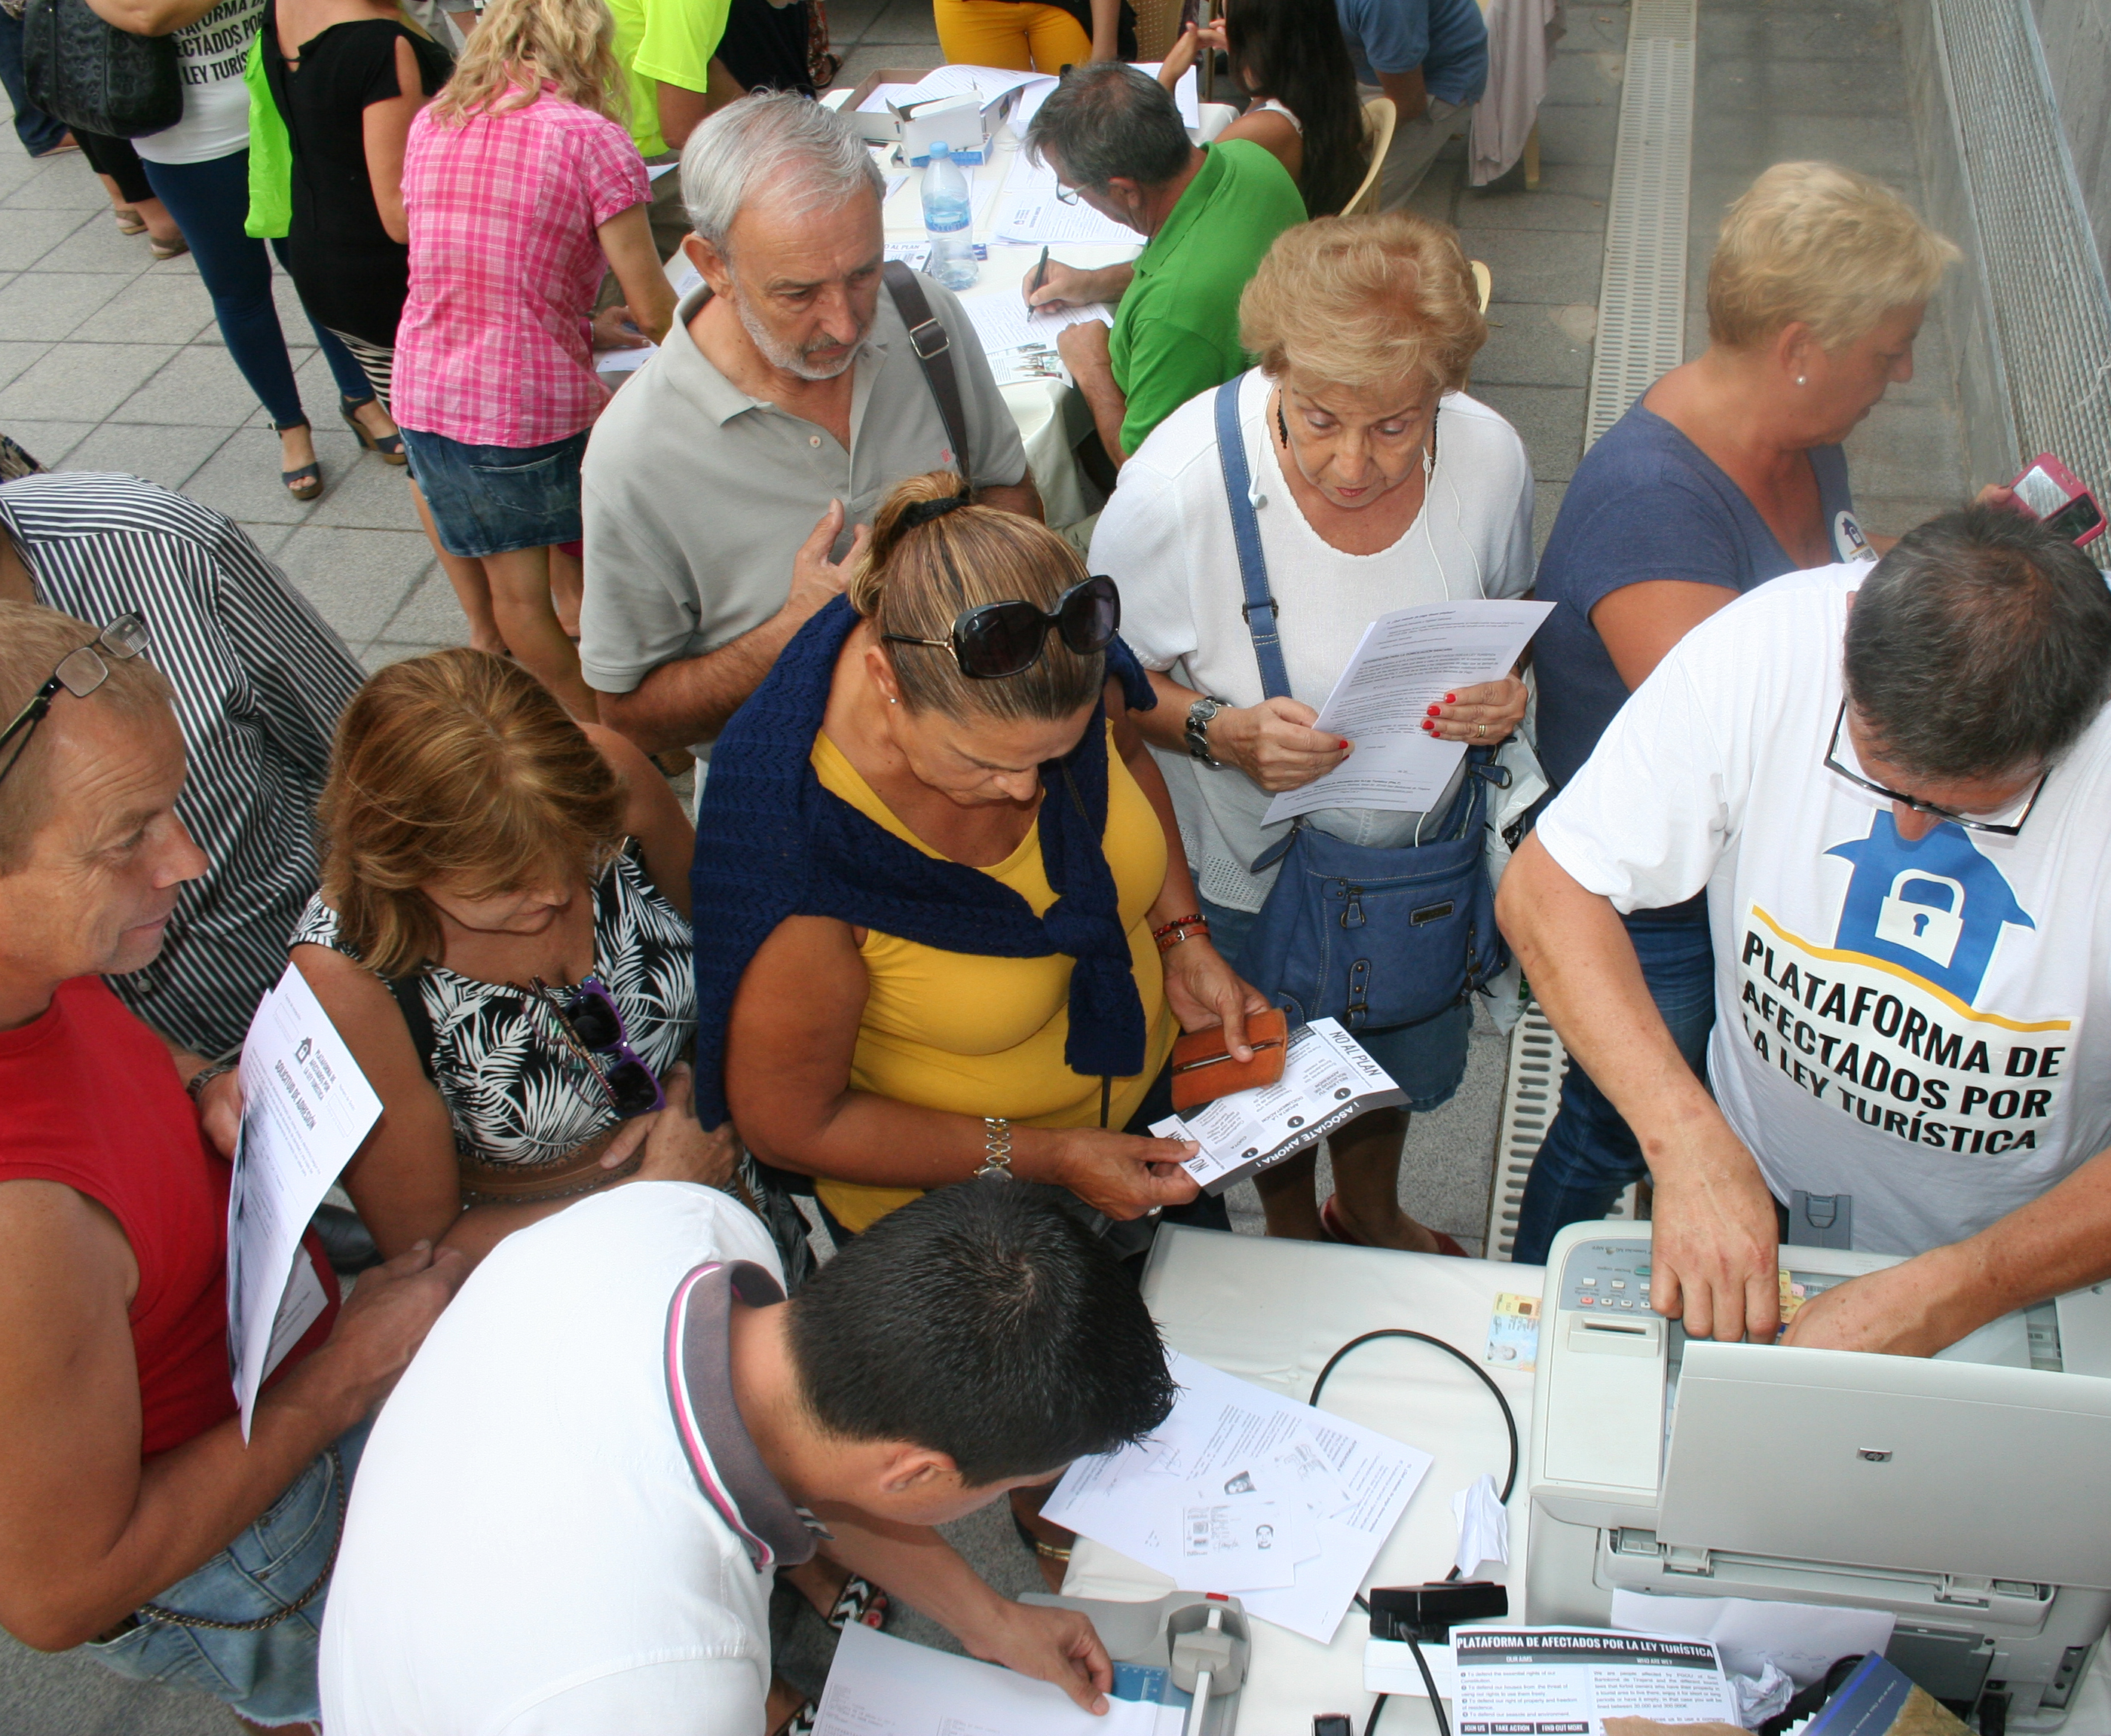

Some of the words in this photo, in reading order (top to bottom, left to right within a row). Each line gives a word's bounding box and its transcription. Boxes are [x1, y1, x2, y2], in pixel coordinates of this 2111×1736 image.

[182, 66, 208, 84] LEY
[1742, 931, 1990, 1074] PLATAFORMA
[2005, 1046, 2066, 1078] DE
[316, 1049, 332, 1078] PLATAFORMA
[330, 1074, 337, 1084] DE
[1329, 1031, 1350, 1044] NO
[1341, 1045, 1360, 1055] AL
[1351, 1055, 1382, 1076] PLAN
[1742, 979, 1950, 1110] AFECTADOS
[1960, 1086, 2052, 1120] POR
[275, 1059, 295, 1093] SOLICITUD
[310, 1059, 326, 1084] AFECTADOS
[291, 1088, 301, 1102] DE
[1779, 1048, 1829, 1098] LEY
[1838, 1111, 2036, 1155] TURÍSTICA
[295, 1097, 317, 1131] ADHESIÓN
[1301, 1106, 1354, 1142] ASÓCIATE
[1189, 1159, 1210, 1173] NO
[1262, 1138, 1299, 1163] AHORA
[1457, 1637, 1525, 1649] PLATAFORMA
[1526, 1637, 1540, 1647] DE
[1541, 1637, 1601, 1649] AFECTADOS
[1602, 1639, 1623, 1649] POR
[1626, 1640, 1639, 1651] LA
[1641, 1641, 1657, 1652] LEY
[1657, 1643, 1714, 1658] TURÍSTICA
